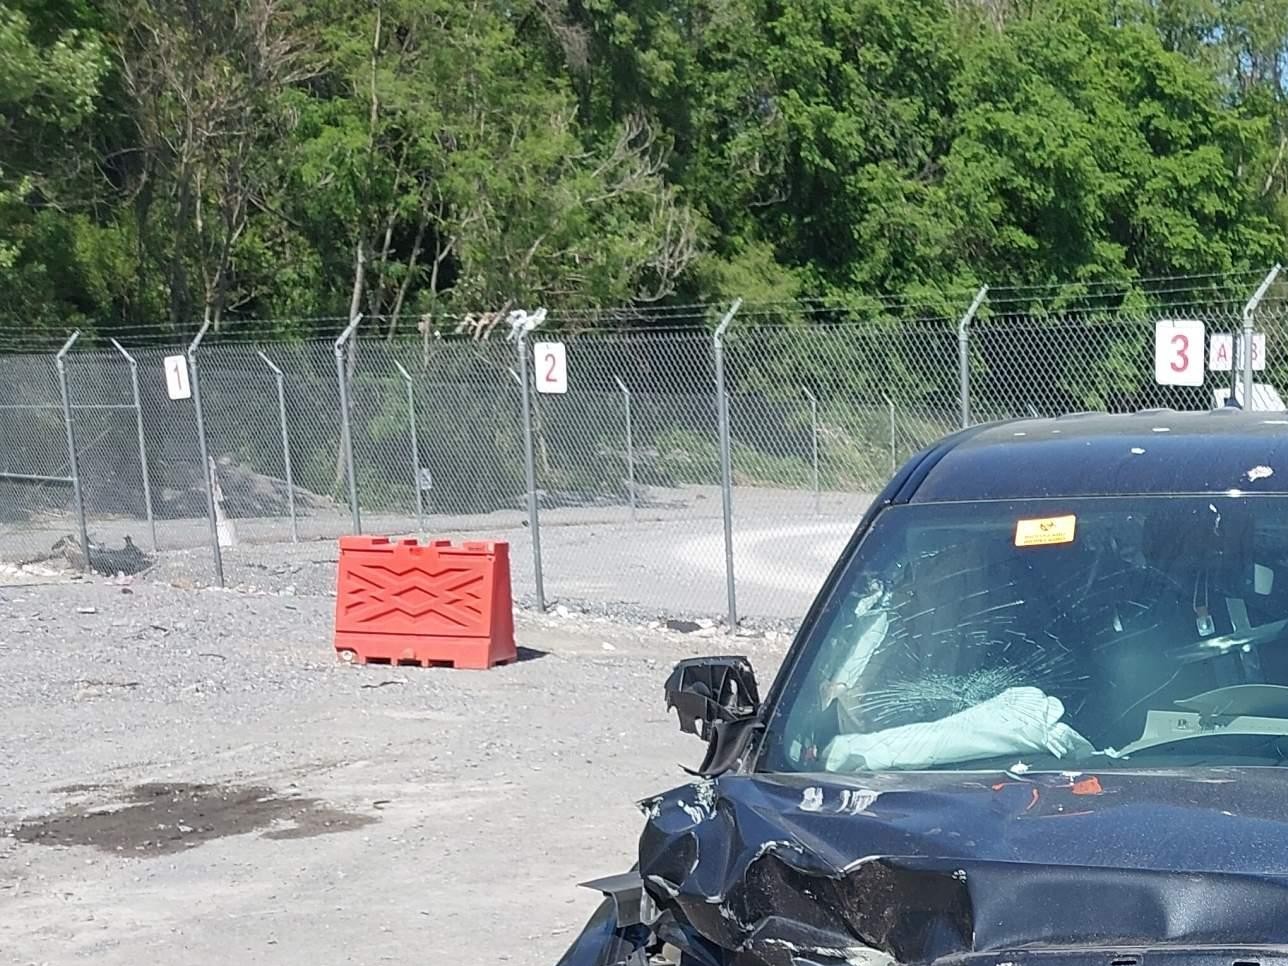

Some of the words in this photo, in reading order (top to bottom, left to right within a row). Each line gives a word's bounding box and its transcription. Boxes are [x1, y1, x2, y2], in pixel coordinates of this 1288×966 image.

[1170, 334, 1189, 373] 3
[1217, 343, 1228, 361] A
[174, 362, 183, 392] 1
[545, 353, 557, 384] 2
